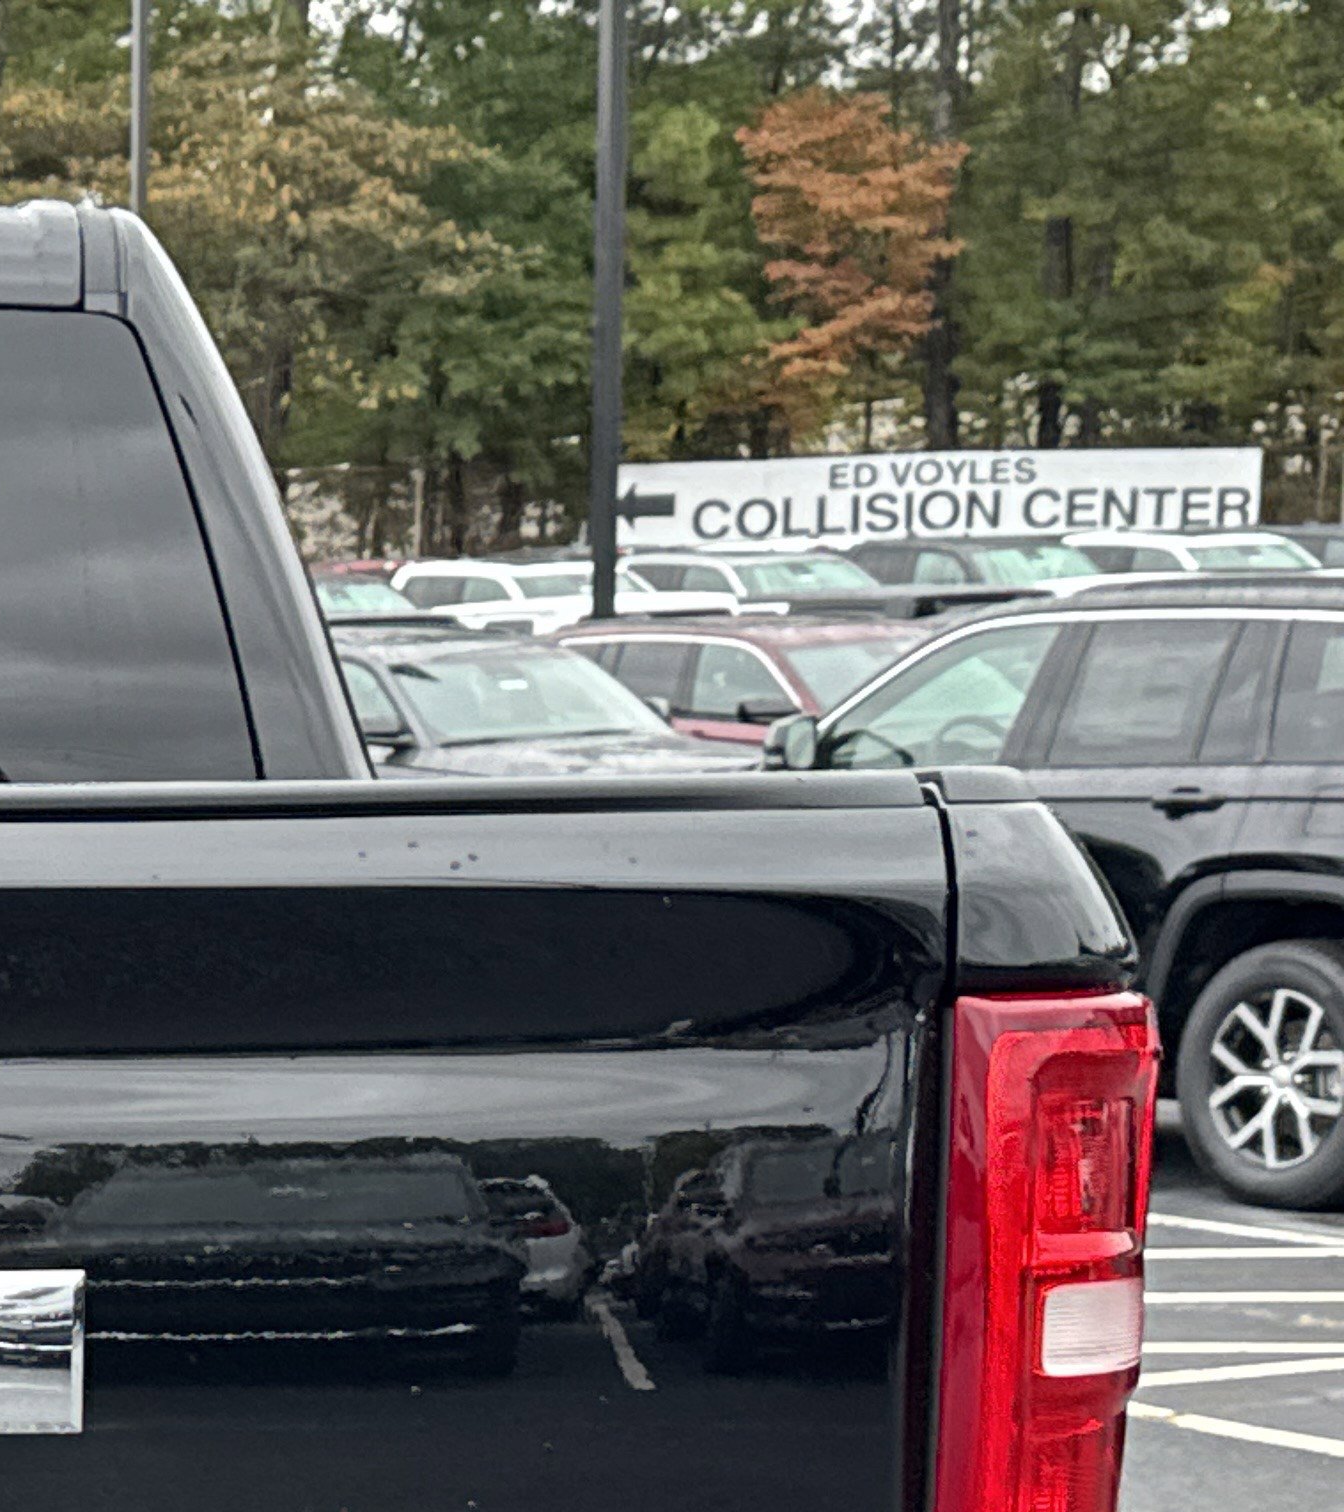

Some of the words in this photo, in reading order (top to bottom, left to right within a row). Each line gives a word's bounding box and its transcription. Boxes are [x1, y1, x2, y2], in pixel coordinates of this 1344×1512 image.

[828, 462, 877, 489] ED
[892, 457, 1037, 486] VOYLES
[692, 488, 1001, 540] COLLISION
[1023, 486, 1252, 530] CENTER
